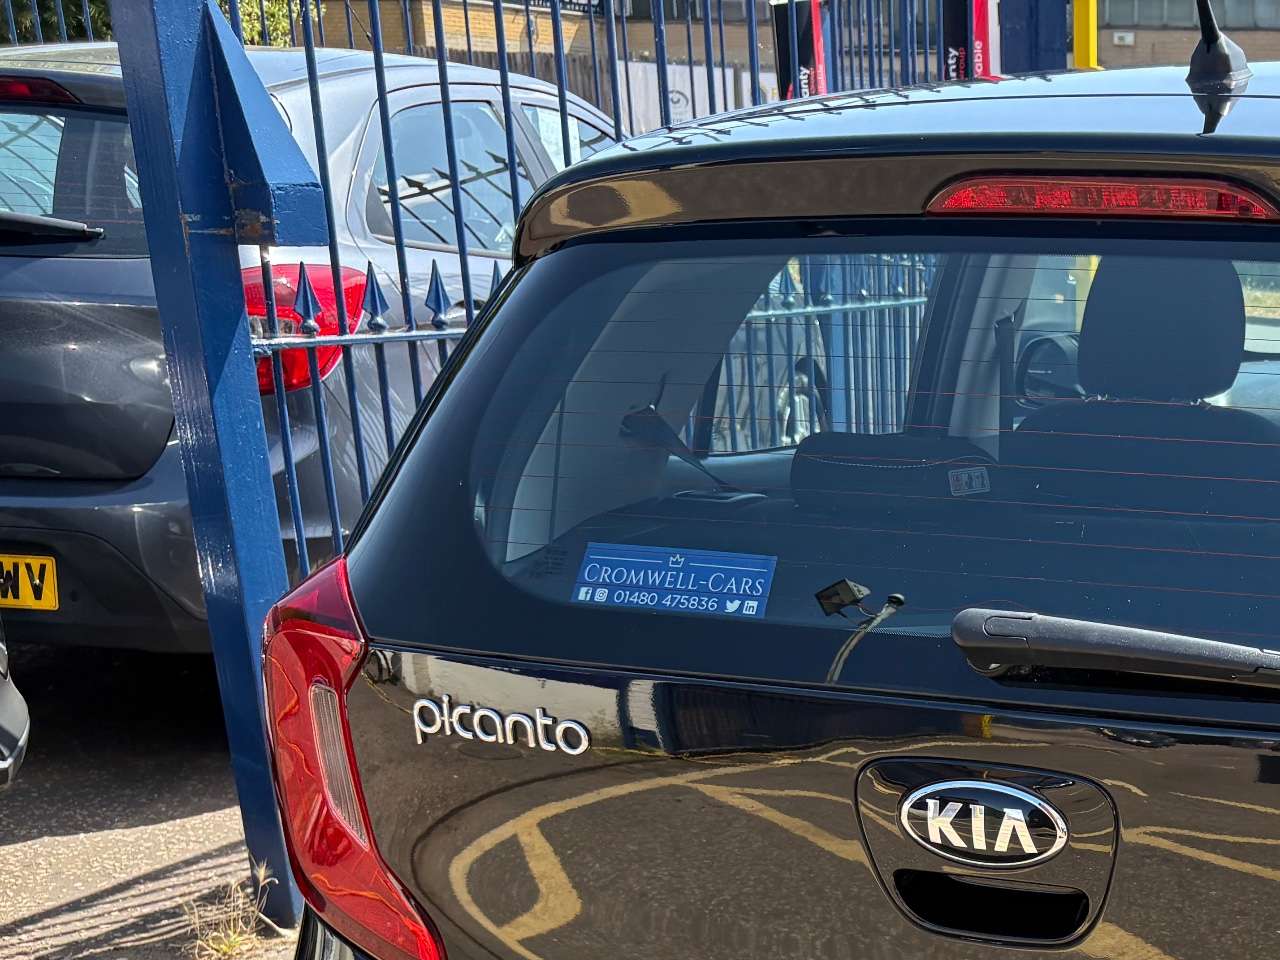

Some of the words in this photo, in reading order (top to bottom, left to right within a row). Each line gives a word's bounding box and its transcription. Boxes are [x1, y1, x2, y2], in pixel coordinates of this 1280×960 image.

[584, 563, 765, 597] CROMWELL-CARS
[613, 589, 658, 606] 01480
[661, 594, 718, 611] 475836
[413, 694, 590, 756] picanto
[925, 798, 1039, 854] KIA
